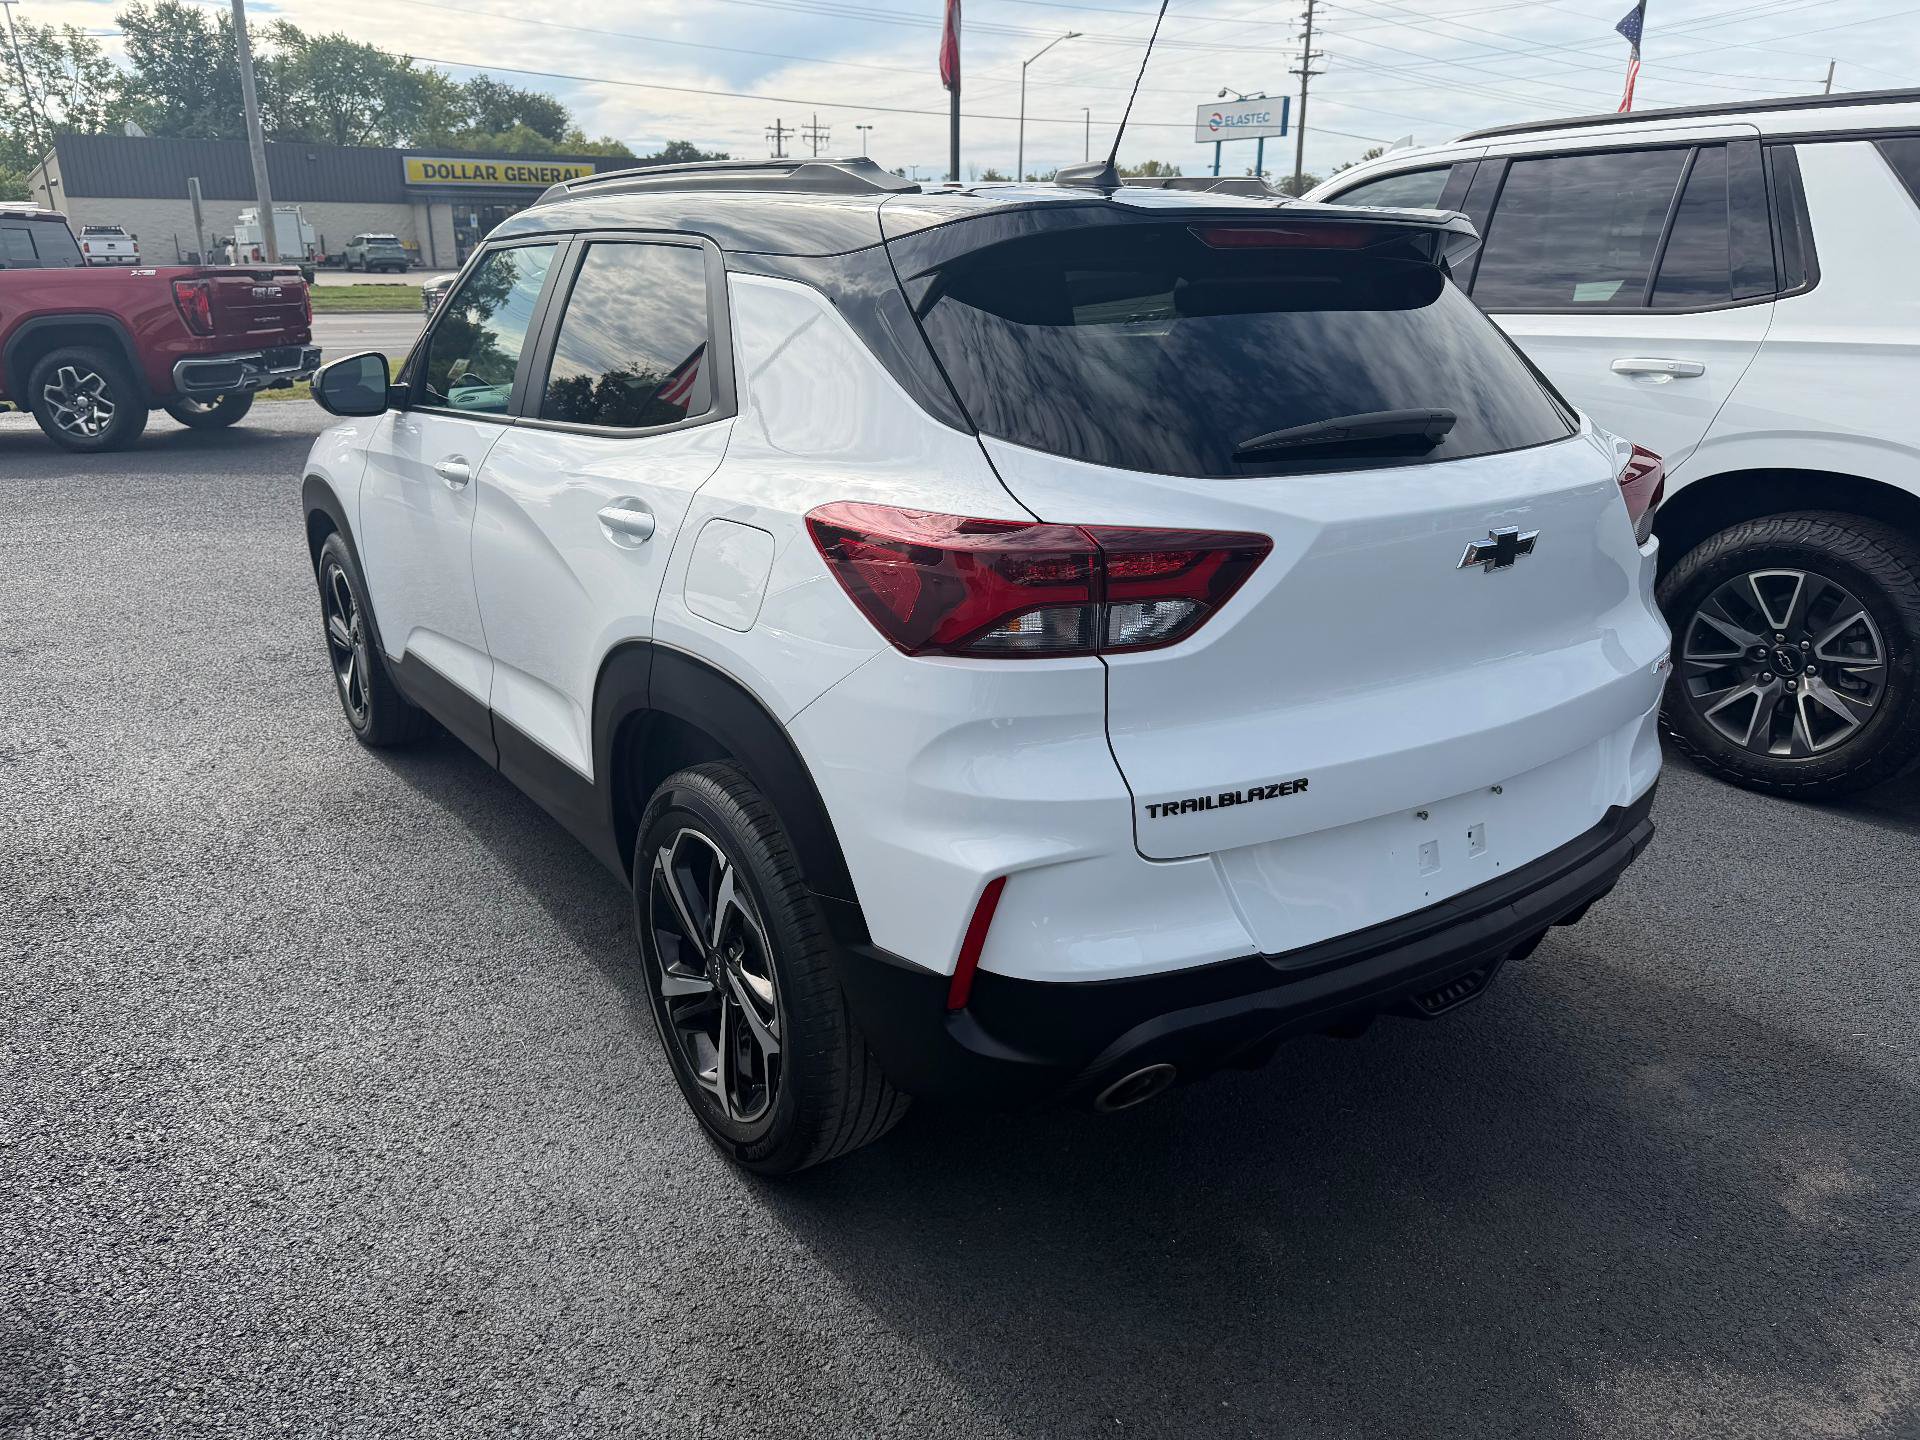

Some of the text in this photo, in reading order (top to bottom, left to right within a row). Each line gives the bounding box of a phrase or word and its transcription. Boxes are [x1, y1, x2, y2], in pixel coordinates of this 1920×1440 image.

[1225, 112, 1270, 126] ELASTEC
[422, 164, 497, 181] DOLLAR
[1145, 778, 1308, 818] TRAILBLAZER
